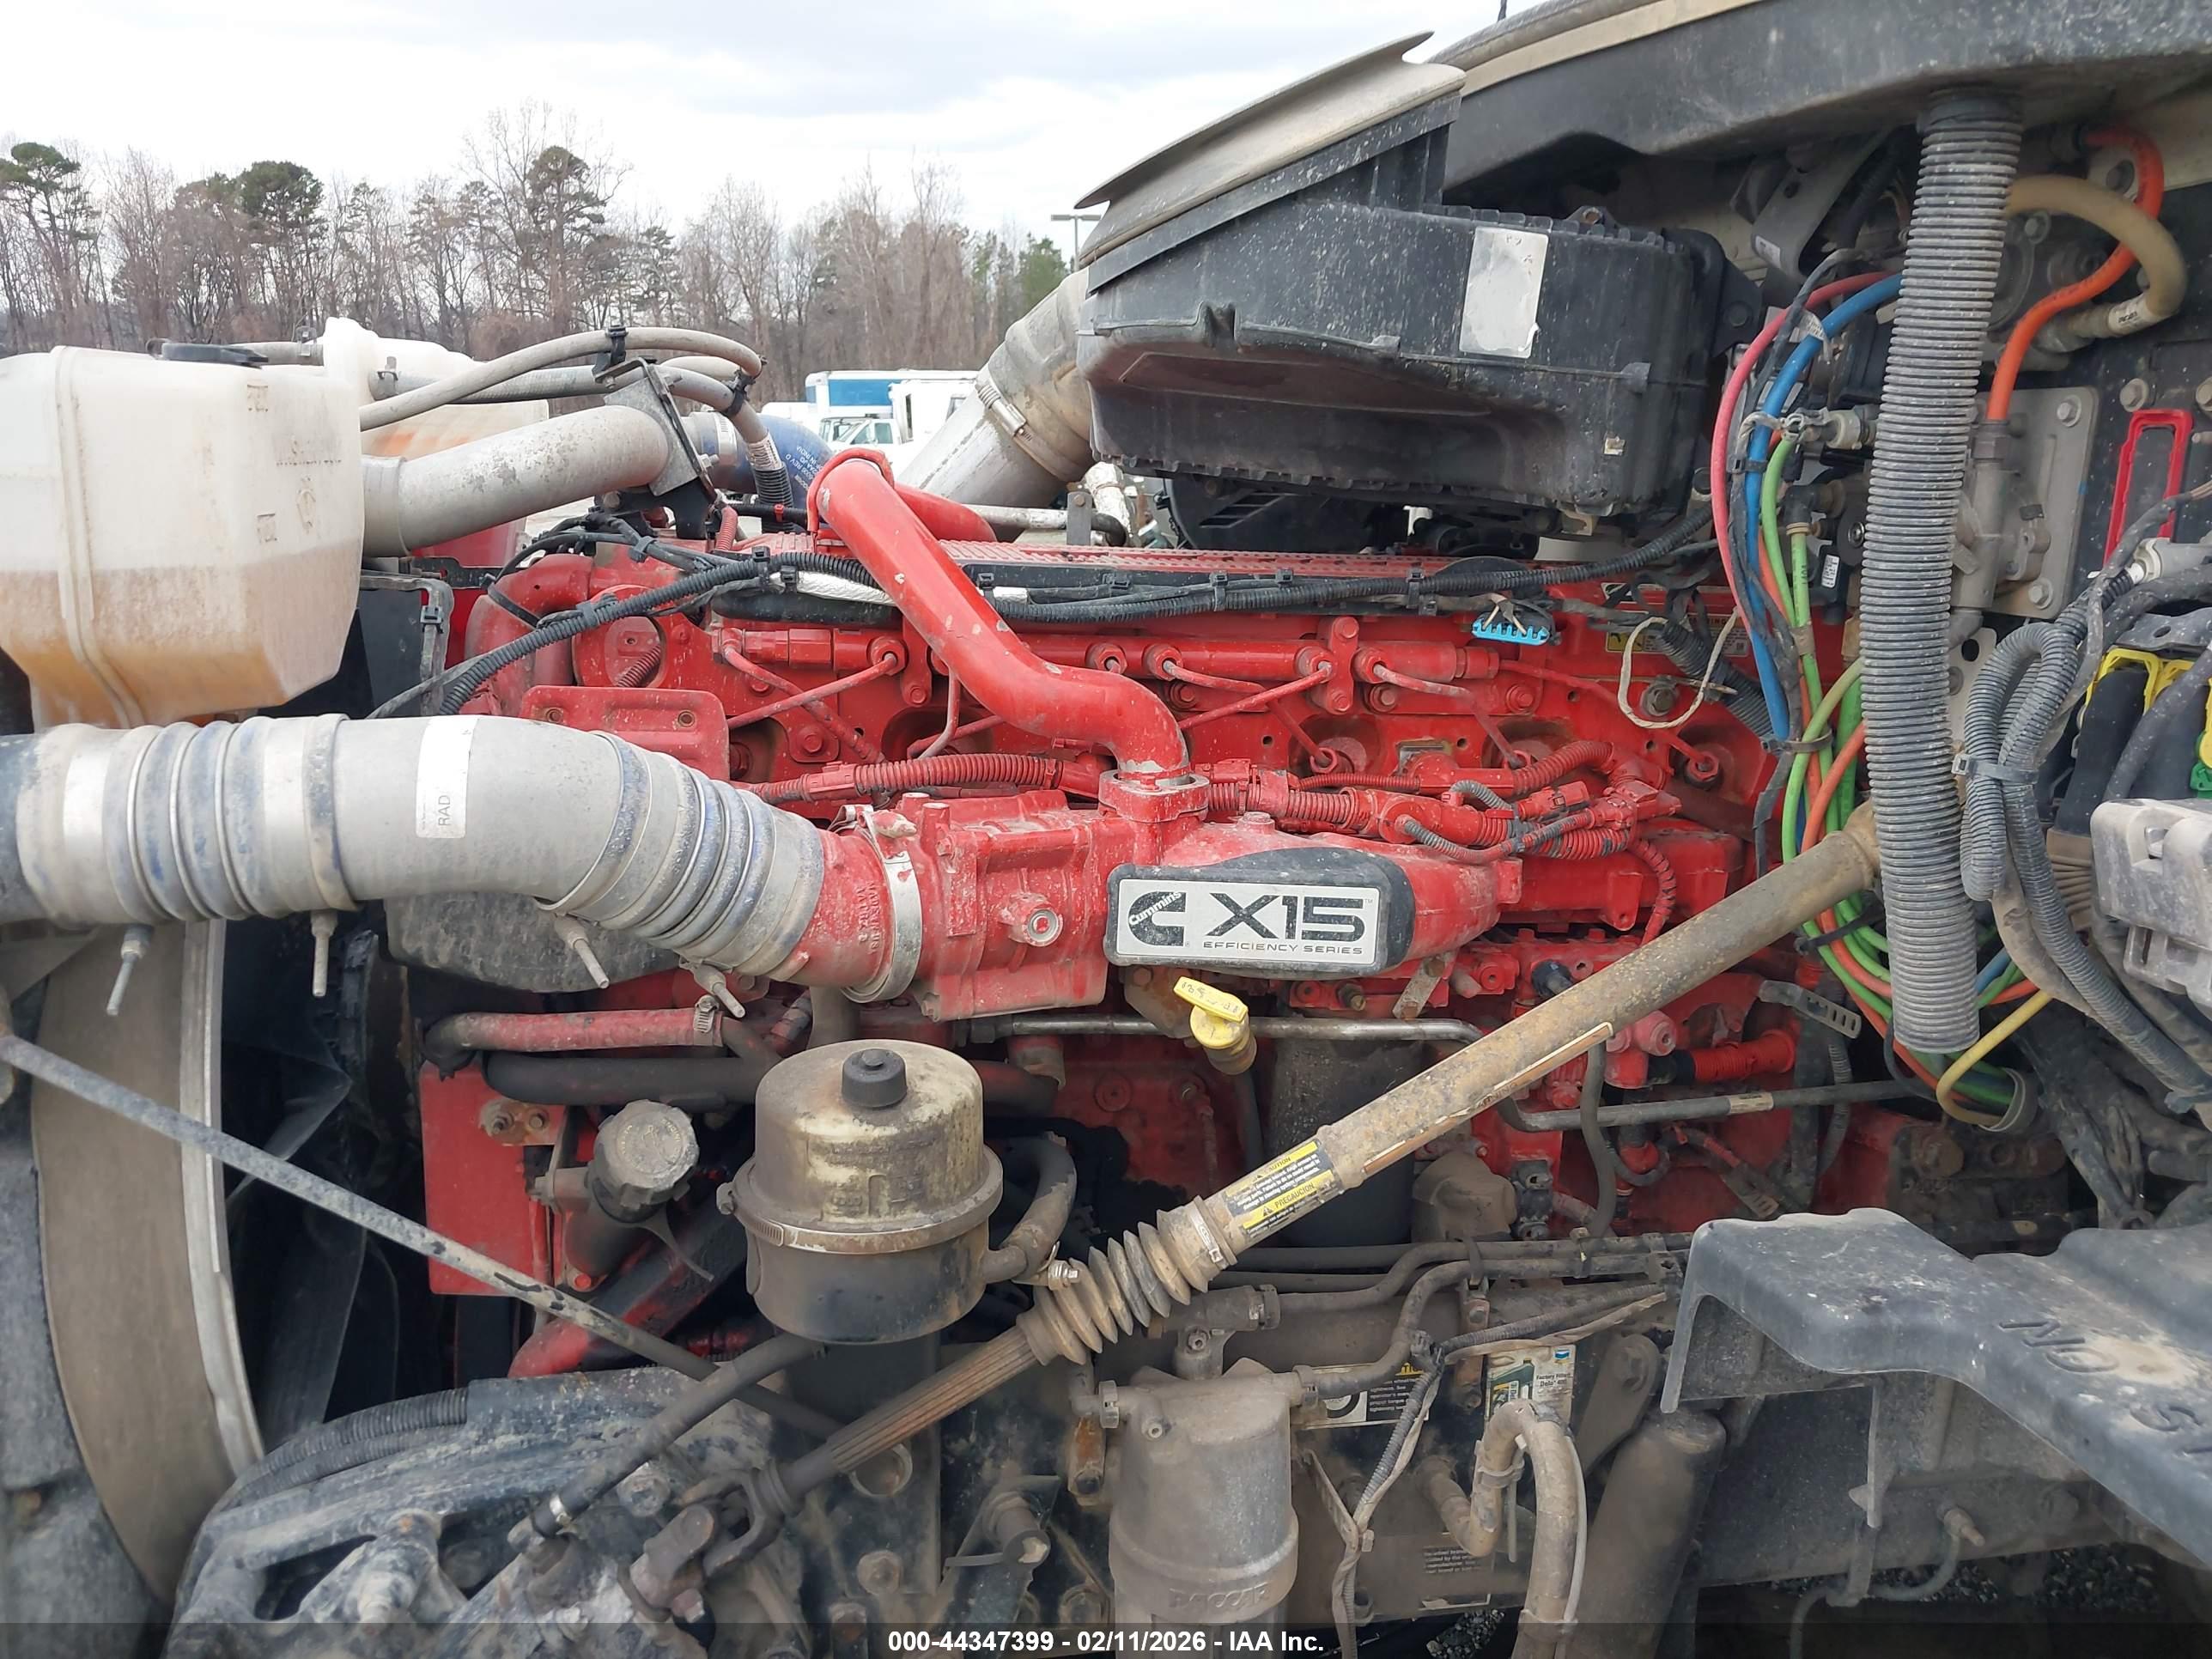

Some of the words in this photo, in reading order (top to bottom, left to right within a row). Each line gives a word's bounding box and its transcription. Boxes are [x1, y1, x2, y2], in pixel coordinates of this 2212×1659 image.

[1128, 890, 1182, 927] Cummins
[1206, 893, 1365, 943] X15
[1204, 941, 1297, 953] EFFICIENCY
[1304, 945, 1363, 955] SERIES
